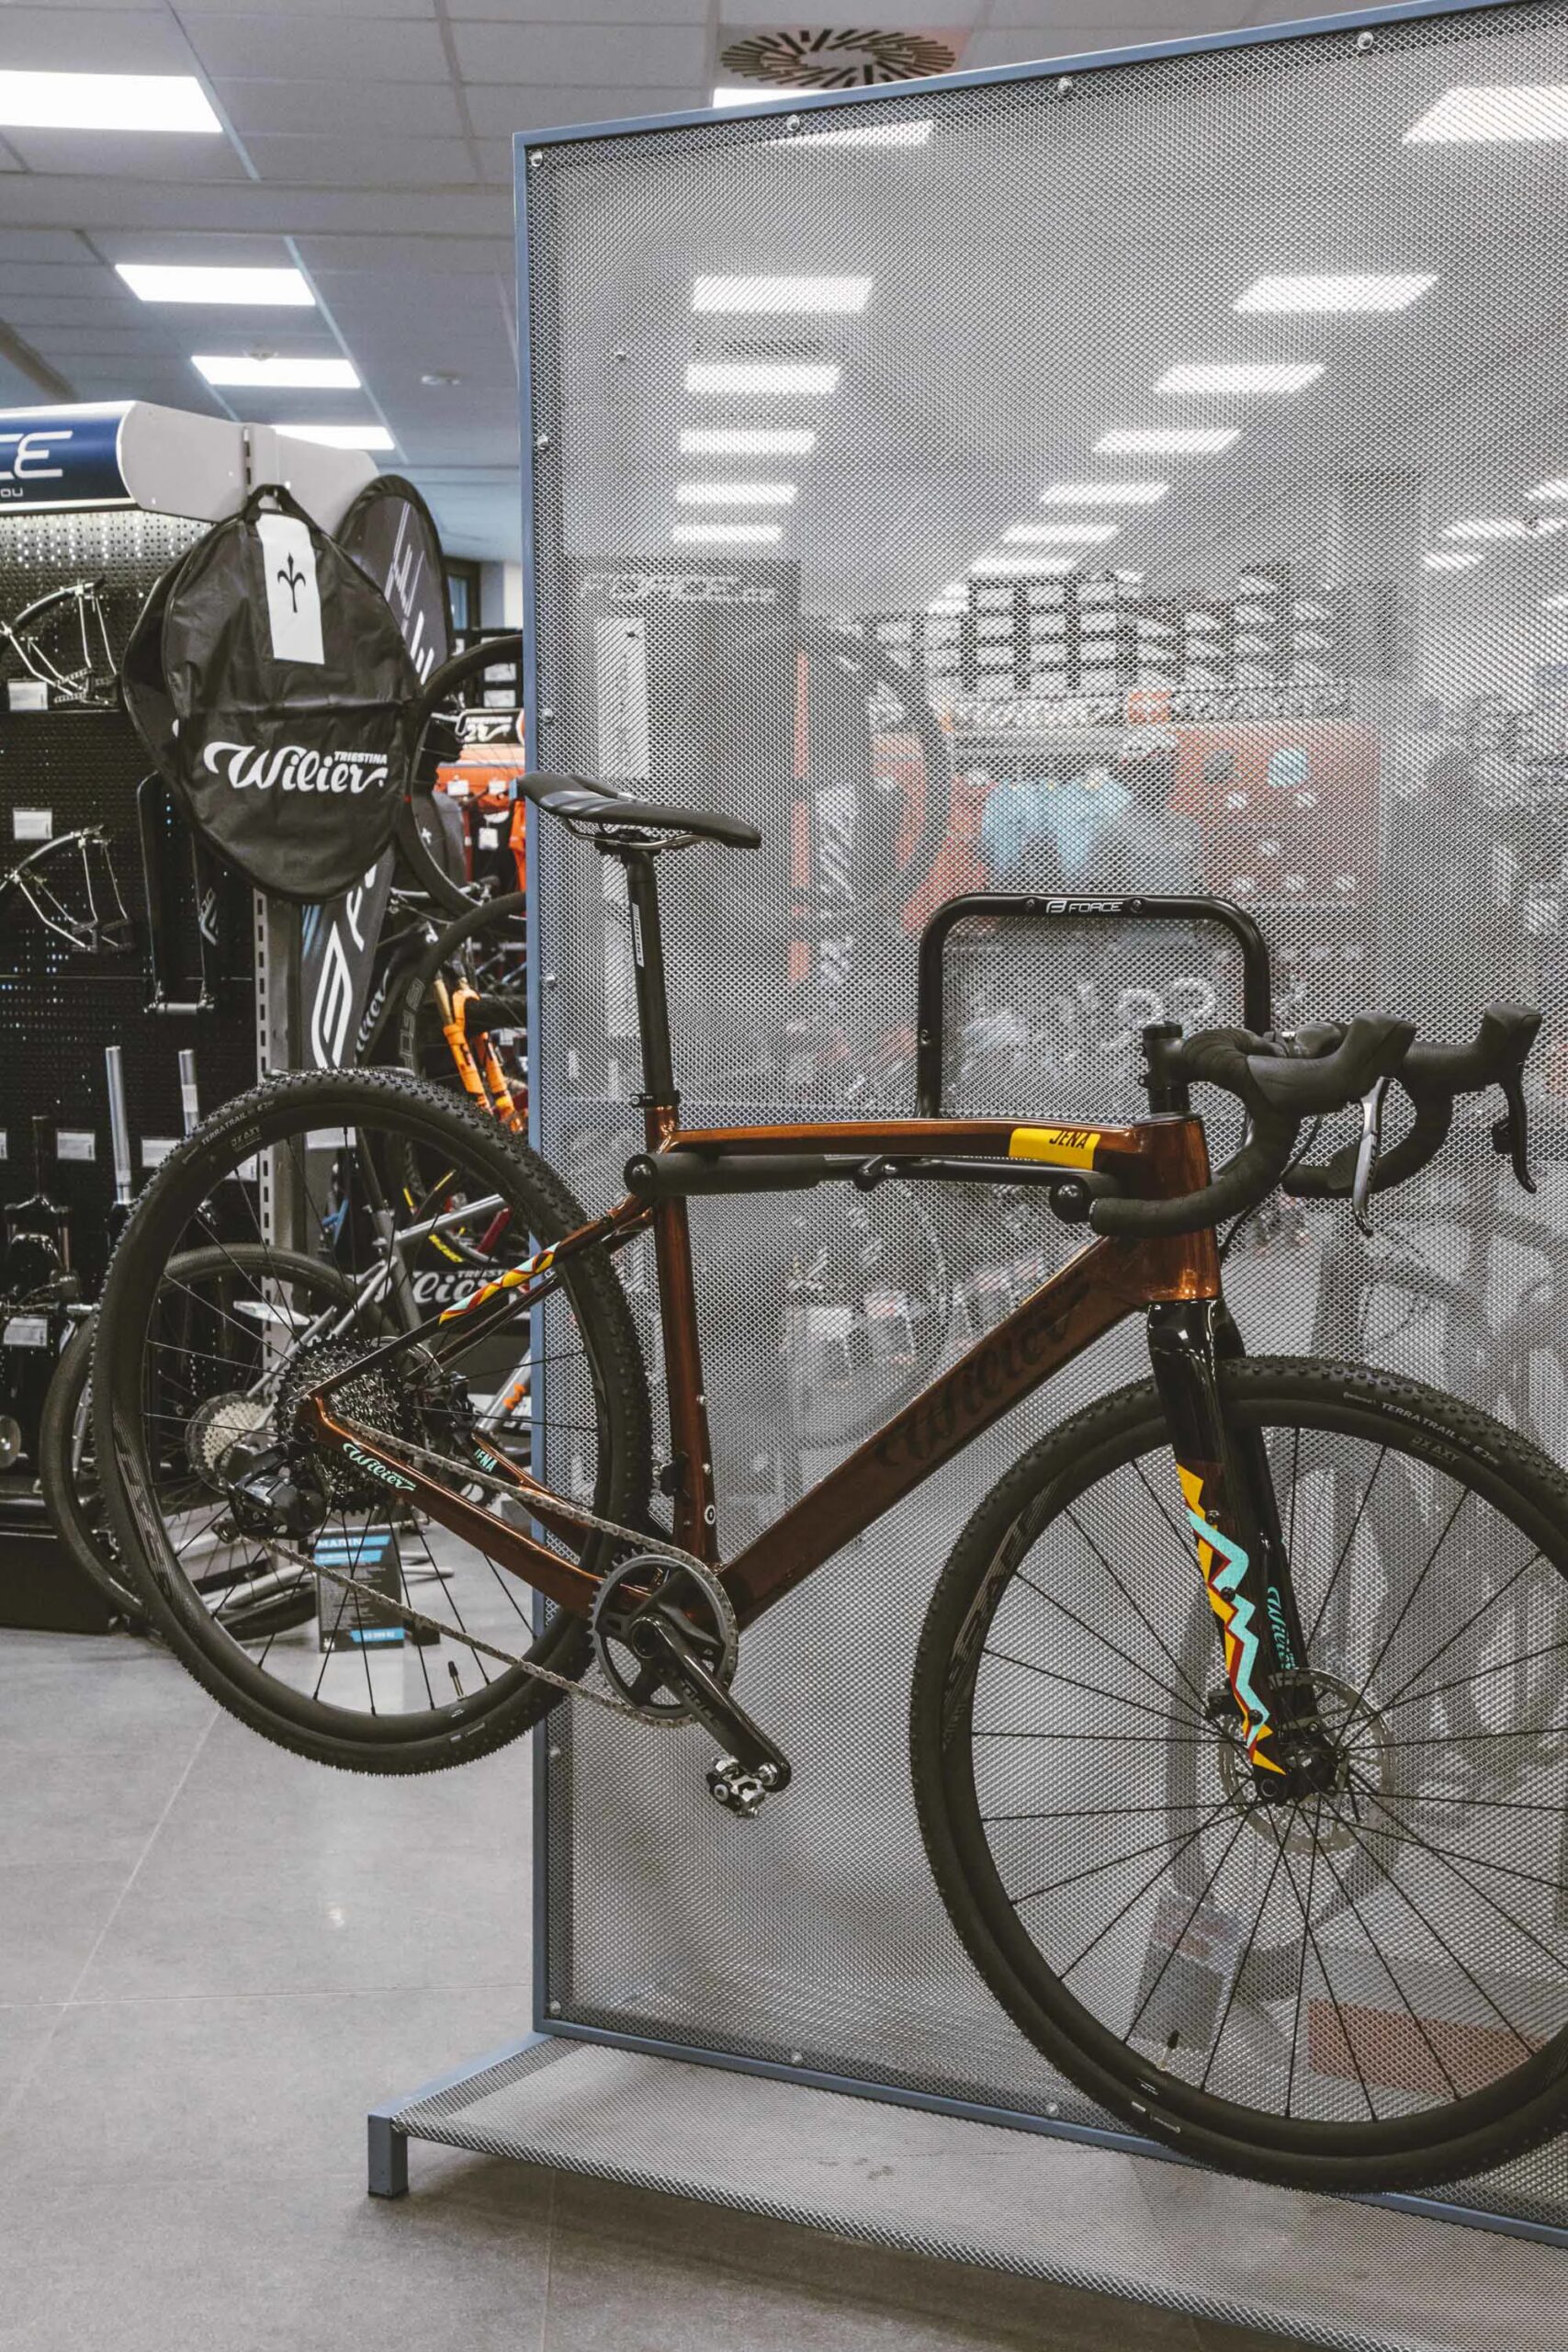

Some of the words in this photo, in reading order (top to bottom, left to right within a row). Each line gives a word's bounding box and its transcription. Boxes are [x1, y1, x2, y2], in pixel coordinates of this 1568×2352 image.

[203, 741, 389, 793] Wilier
[334, 751, 388, 764] TRIESTINA
[1068, 901, 1123, 913] FORCE
[1049, 1130, 1089, 1150] JENA
[1381, 1402, 1421, 1422] TERRA
[1422, 1418, 1456, 1440] TRAIL
[343, 1442, 415, 1492] Wilier
